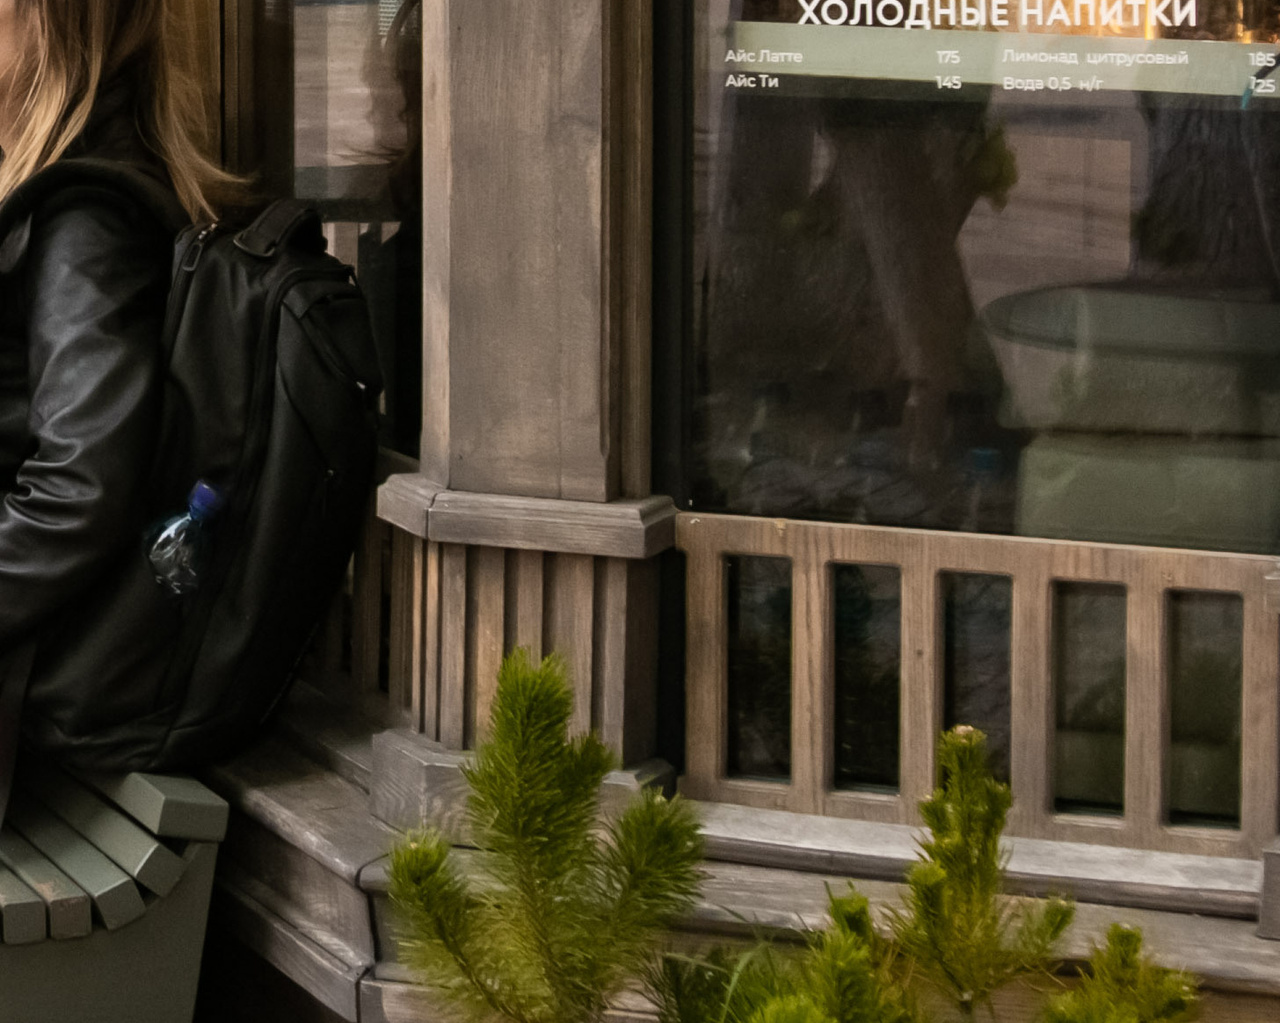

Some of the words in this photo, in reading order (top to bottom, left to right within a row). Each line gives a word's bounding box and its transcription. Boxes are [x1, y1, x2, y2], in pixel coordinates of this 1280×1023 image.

[725, 49, 756, 63] Айс
[758, 49, 803, 63] Латте
[936, 50, 960, 64] 175
[1002, 49, 1079, 65] Лимонад
[1087, 50, 1189, 66] цитрусовый
[1248, 52, 1276, 67] 185
[725, 74, 756, 88] Айс
[759, 74, 779, 88] Ти
[935, 76, 962, 90] 145
[1003, 76, 1044, 91] Вода
